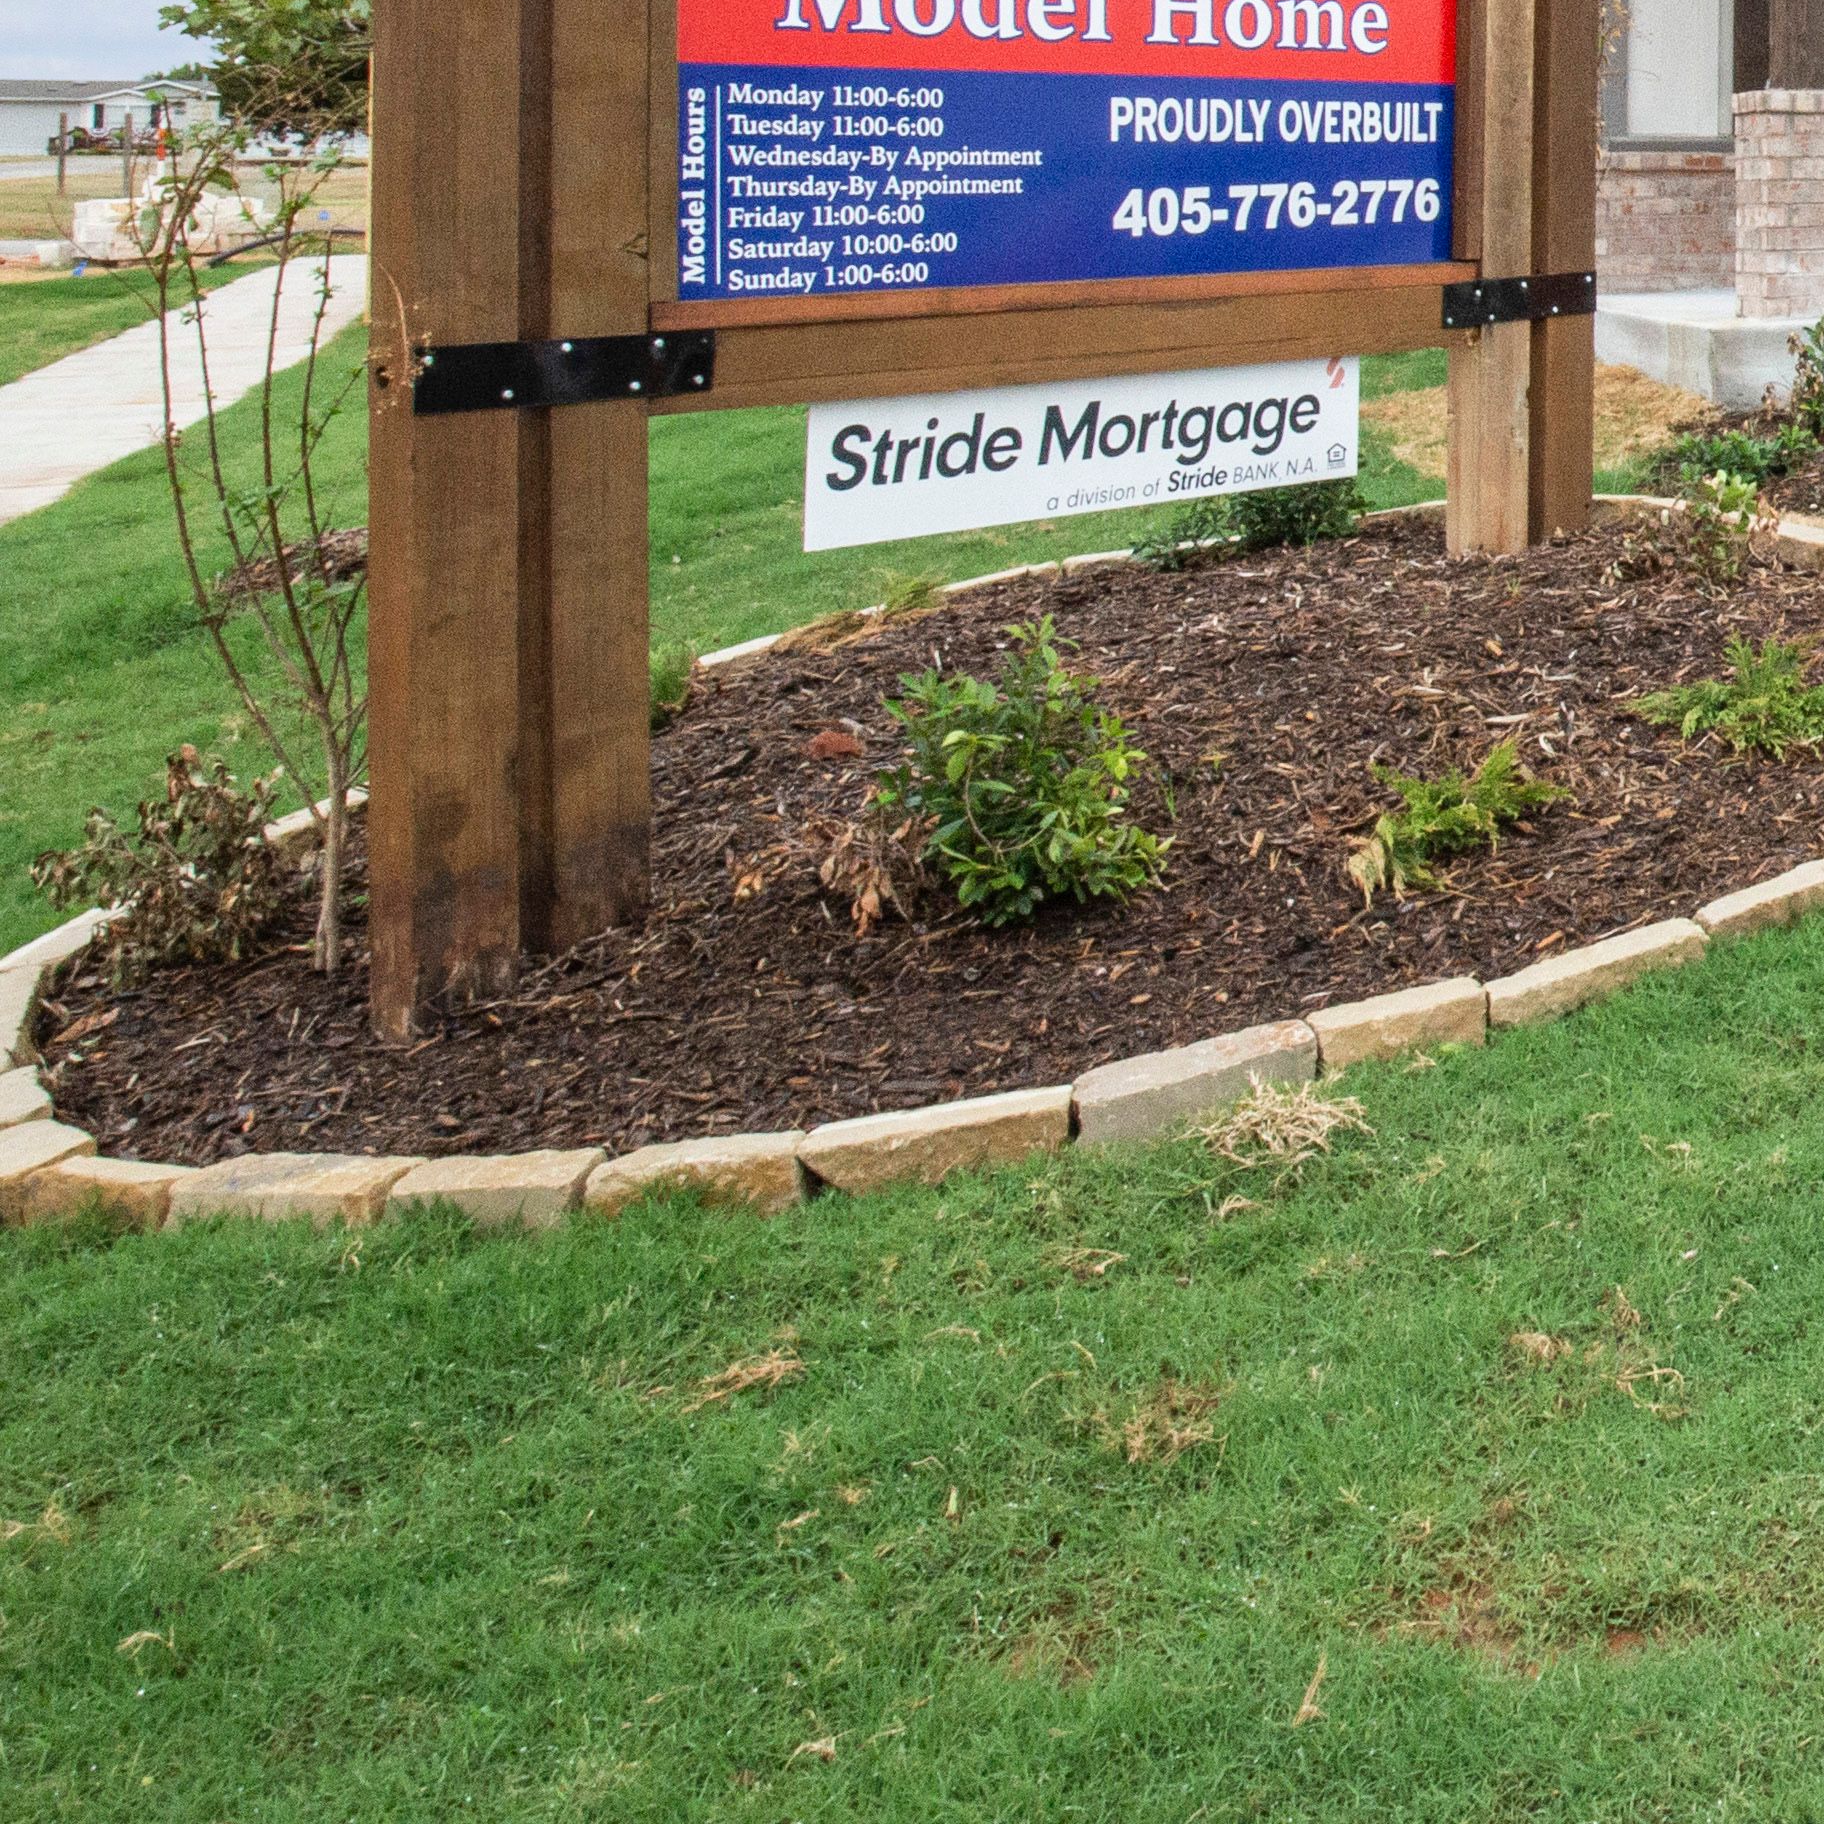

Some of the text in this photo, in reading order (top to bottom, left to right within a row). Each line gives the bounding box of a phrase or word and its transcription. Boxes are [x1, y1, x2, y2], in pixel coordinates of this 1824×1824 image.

[727, 83, 944, 111] Monday 11:00-6:00
[727, 114, 944, 141] Tuesday 11:00-6:00
[1110, 96, 1443, 143] PROUDLY OVERBUILT
[727, 144, 1043, 171] Wednesday-By Appointment
[682, 87, 706, 283] Model Hours
[727, 175, 1023, 201] Thursday-By Appointment
[727, 205, 925, 232] Friday 11:00-6:00
[1112, 178, 1441, 237] 405-776-2776
[727, 233, 958, 262] Saturday 10:00-6:00
[727, 263, 929, 293] Sunday 1:00-6:00
[825, 393, 1321, 492] Stride Mortgage
[1046, 496, 1059, 511] a
[1066, 483, 1136, 509] division
[1143, 478, 1161, 497] of
[1167, 466, 1228, 493] Stride
